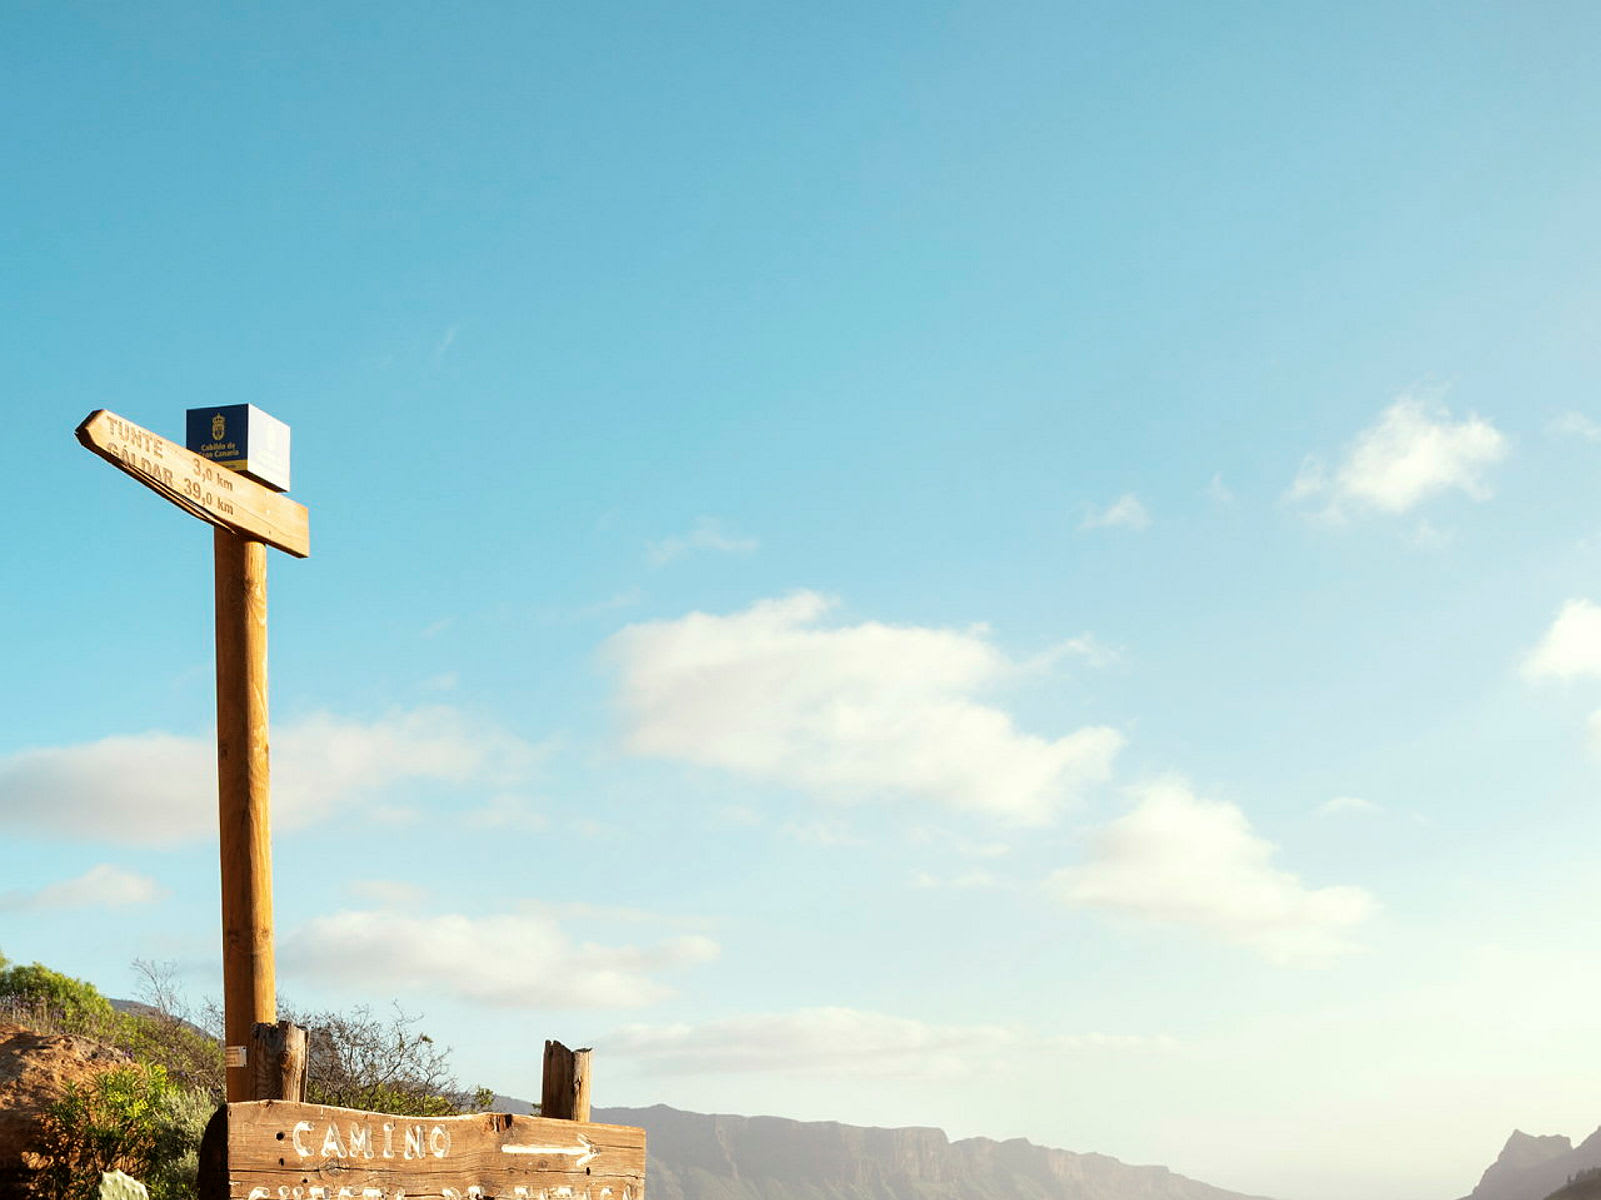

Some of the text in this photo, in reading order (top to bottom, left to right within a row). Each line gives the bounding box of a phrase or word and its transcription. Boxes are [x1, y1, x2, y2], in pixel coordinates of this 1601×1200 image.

[106, 415, 234, 492] TUNTE 3,0 km
[184, 478, 213, 507] 39,0
[217, 497, 234, 515] km
[292, 1120, 451, 1160] CAMINO
